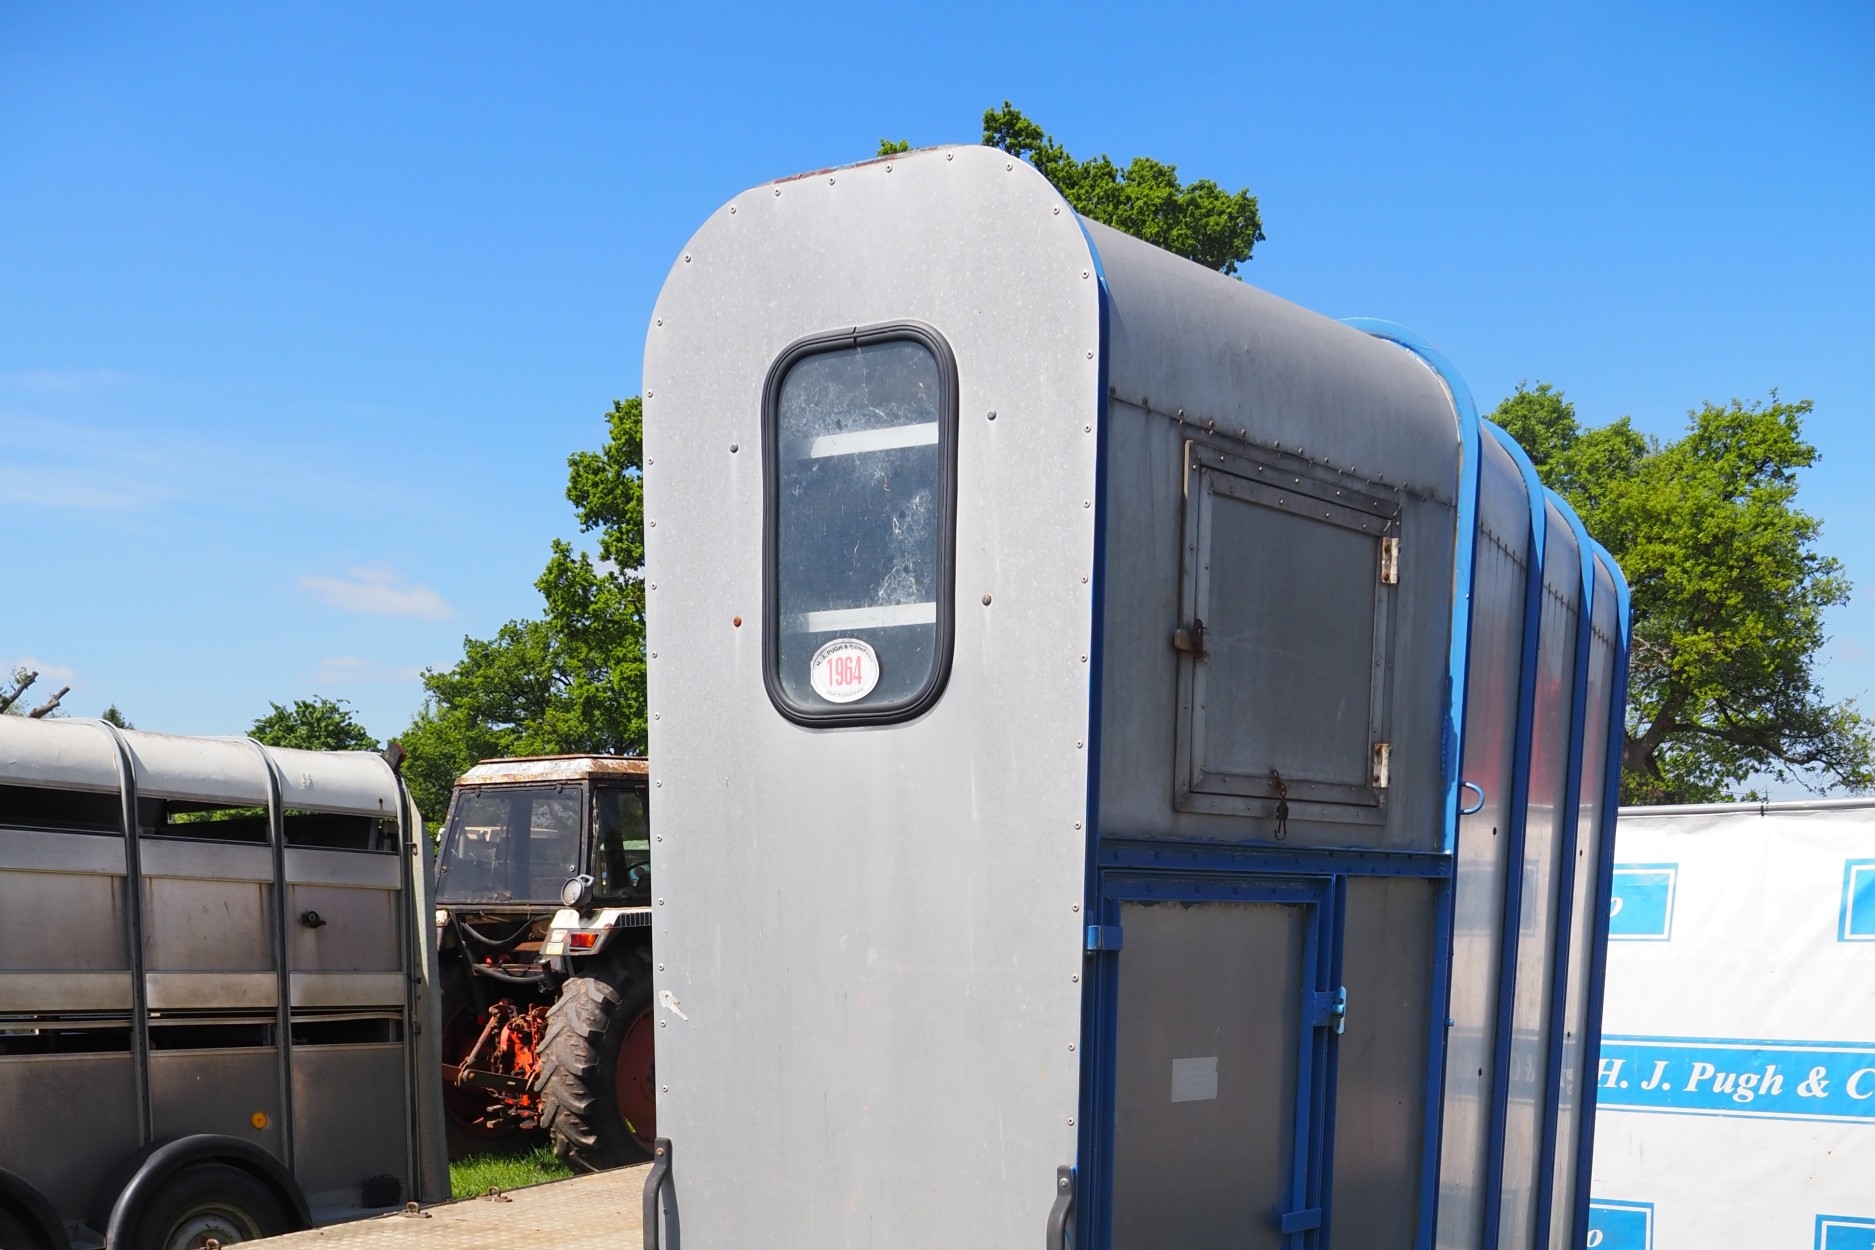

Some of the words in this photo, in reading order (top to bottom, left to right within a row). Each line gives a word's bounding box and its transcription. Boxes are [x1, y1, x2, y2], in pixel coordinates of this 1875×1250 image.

[826, 644, 844, 656] PUGH
[827, 655, 862, 686] 1964
[1598, 1058, 1629, 1089] H.
[1640, 1060, 1671, 1090] J.
[1682, 1062, 1784, 1103] Pugh
[1796, 1066, 1830, 1098] &
